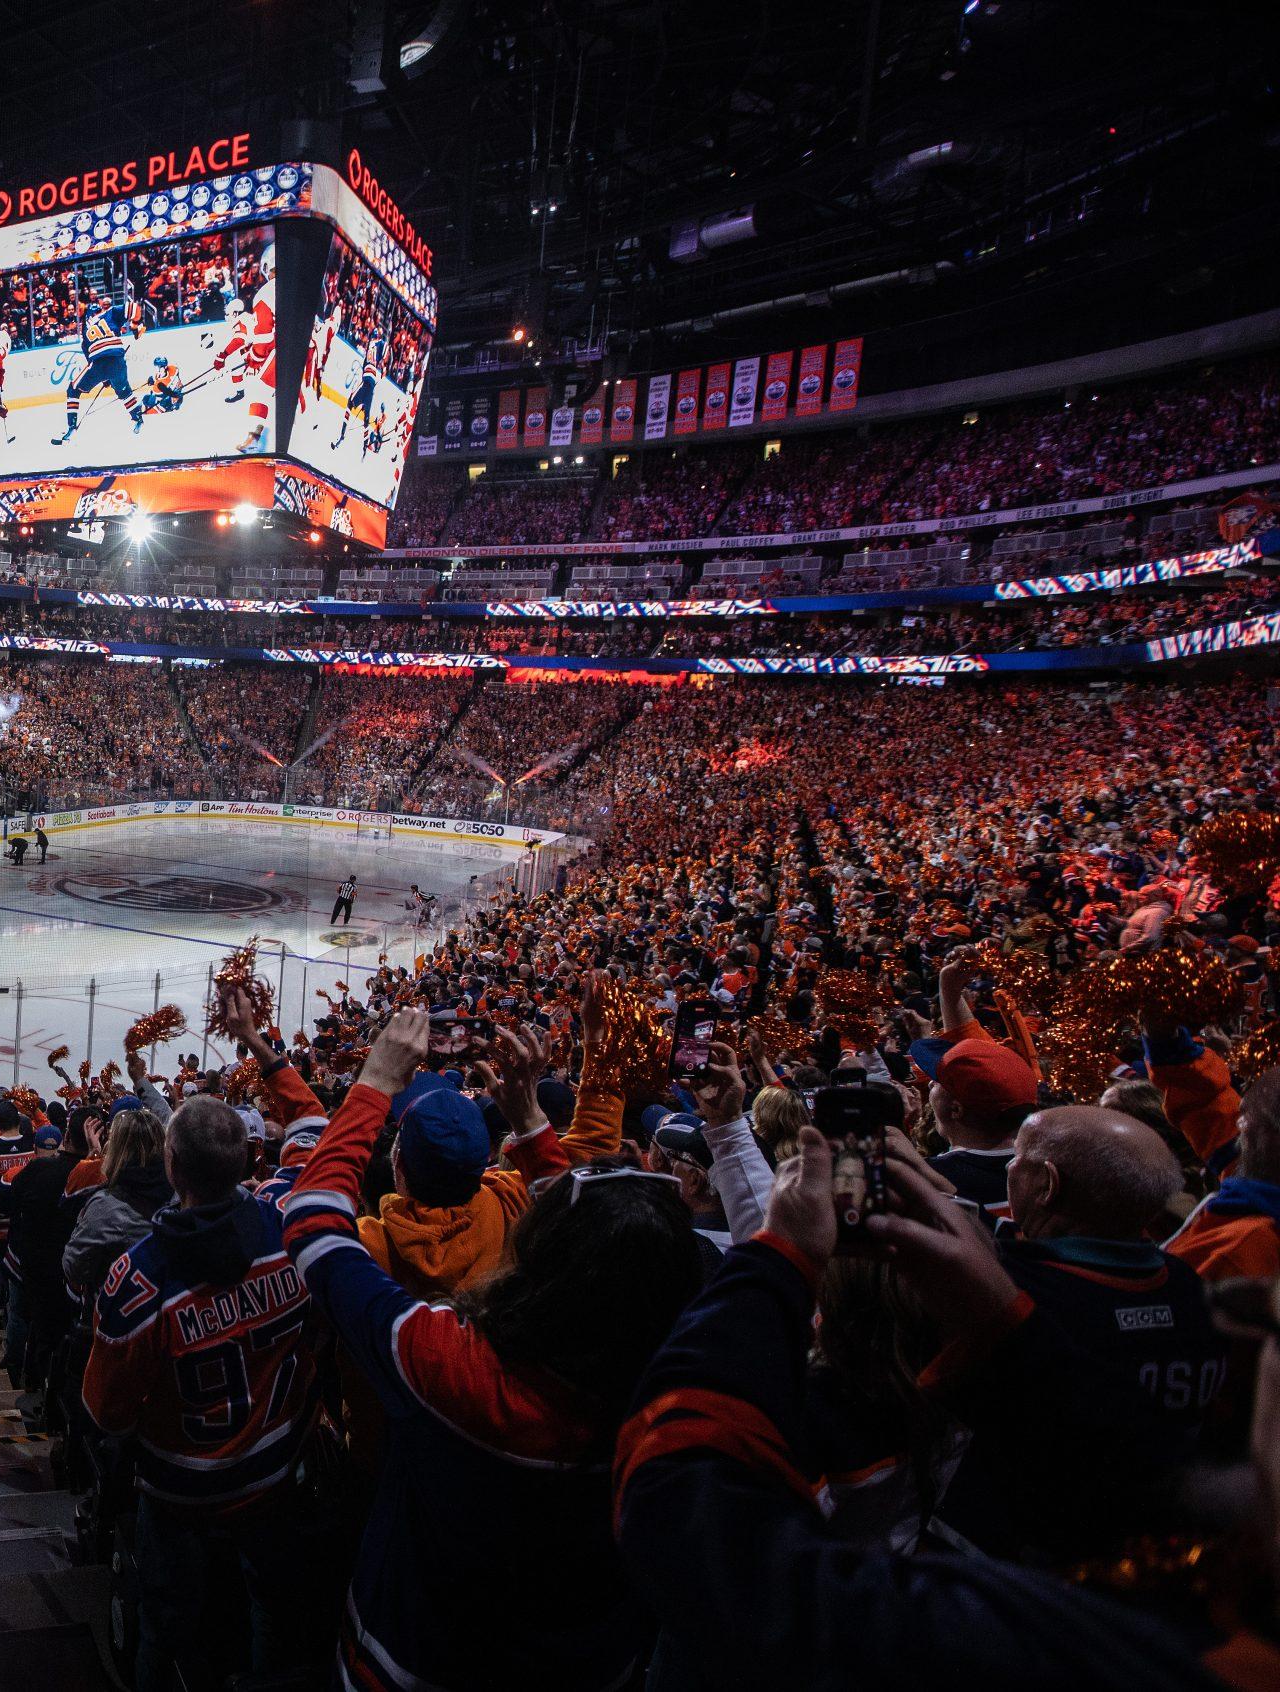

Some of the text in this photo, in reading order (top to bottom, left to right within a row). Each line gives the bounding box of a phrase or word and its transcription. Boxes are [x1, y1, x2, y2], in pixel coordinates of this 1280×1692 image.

[19, 133, 251, 217] ROGERS PLACE
[362, 167, 433, 278] ROGERS PLACE
[86, 317, 115, 342] 91
[883, 524, 917, 536] SATHER
[721, 536, 775, 547] PAUL COFFEY
[791, 531, 842, 543] GRANT FUHR
[405, 545, 623, 557] EDMONTON OILERS HALL OF FAME
[648, 541, 704, 551] MARK MESSIER
[87, 808, 116, 820] Scotiabank
[228, 803, 279, 815] Tim Hortons
[348, 812, 389, 824] ROGERS
[392, 815, 446, 829] betway.net
[472, 823, 505, 836] 5050
[103, 1251, 160, 1318] 97
[176, 1263, 302, 1345] McDAVID
[175, 1320, 305, 1445] 97
